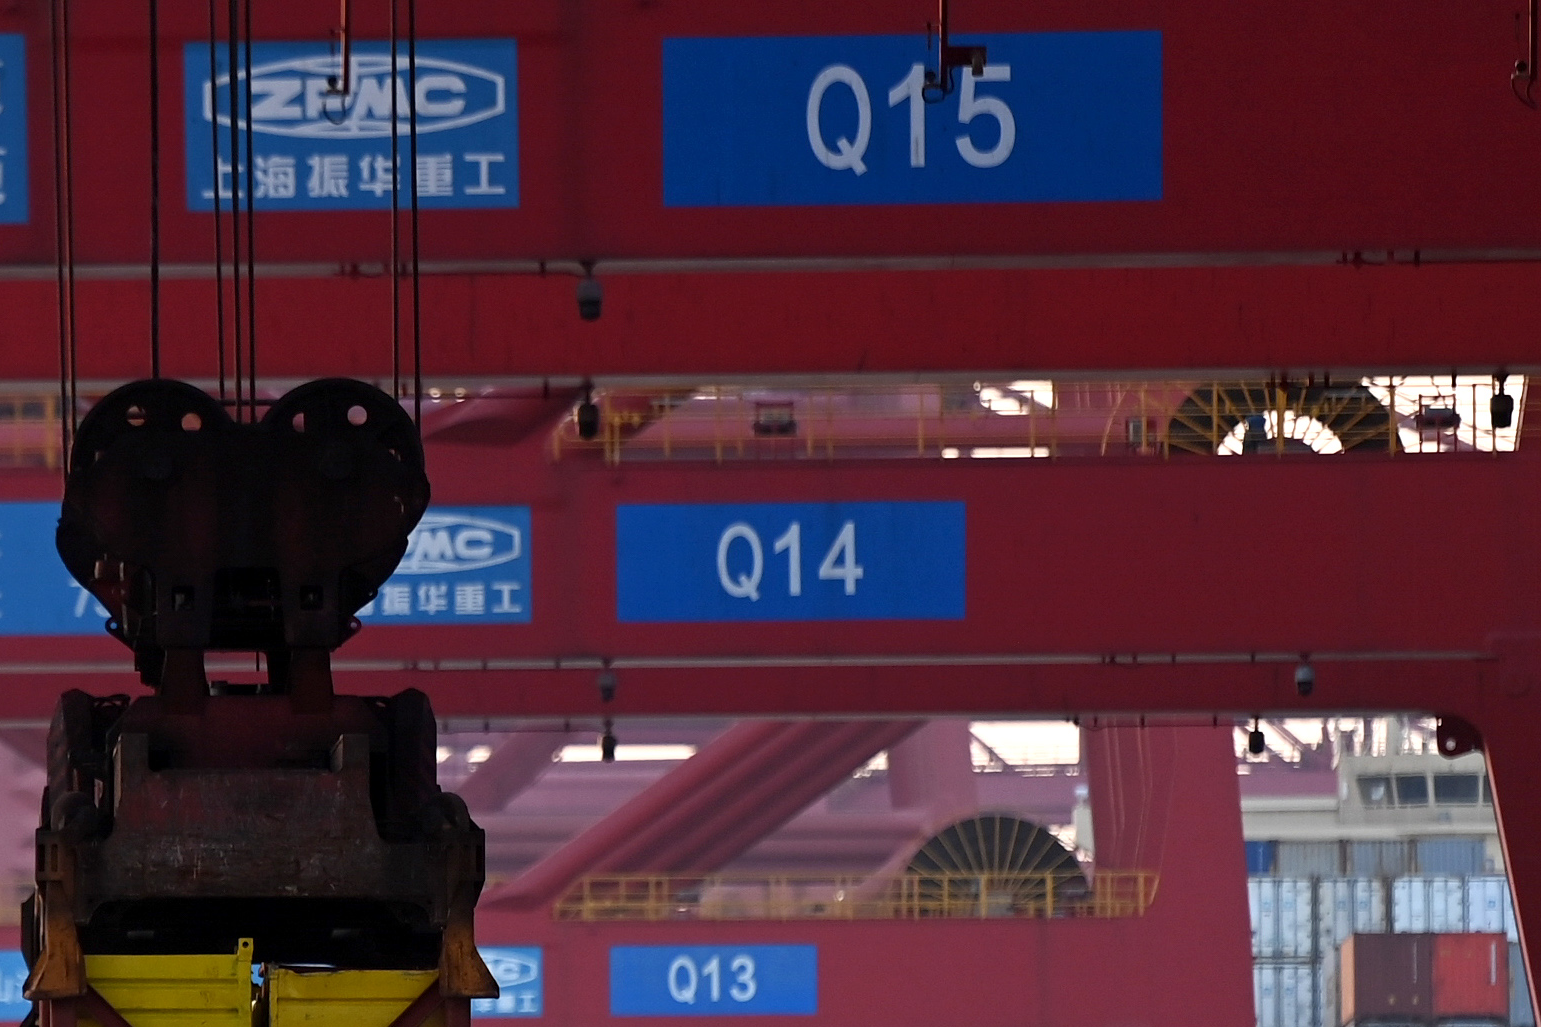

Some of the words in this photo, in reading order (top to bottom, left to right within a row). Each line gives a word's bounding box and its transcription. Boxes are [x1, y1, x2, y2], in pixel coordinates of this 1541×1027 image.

[250, 74, 467, 121] ZPMC
[806, 63, 1017, 177] Q15
[202, 152, 506, 199] 上海振华重工
[716, 520, 865, 602] Q14
[667, 954, 757, 1005] Q13
